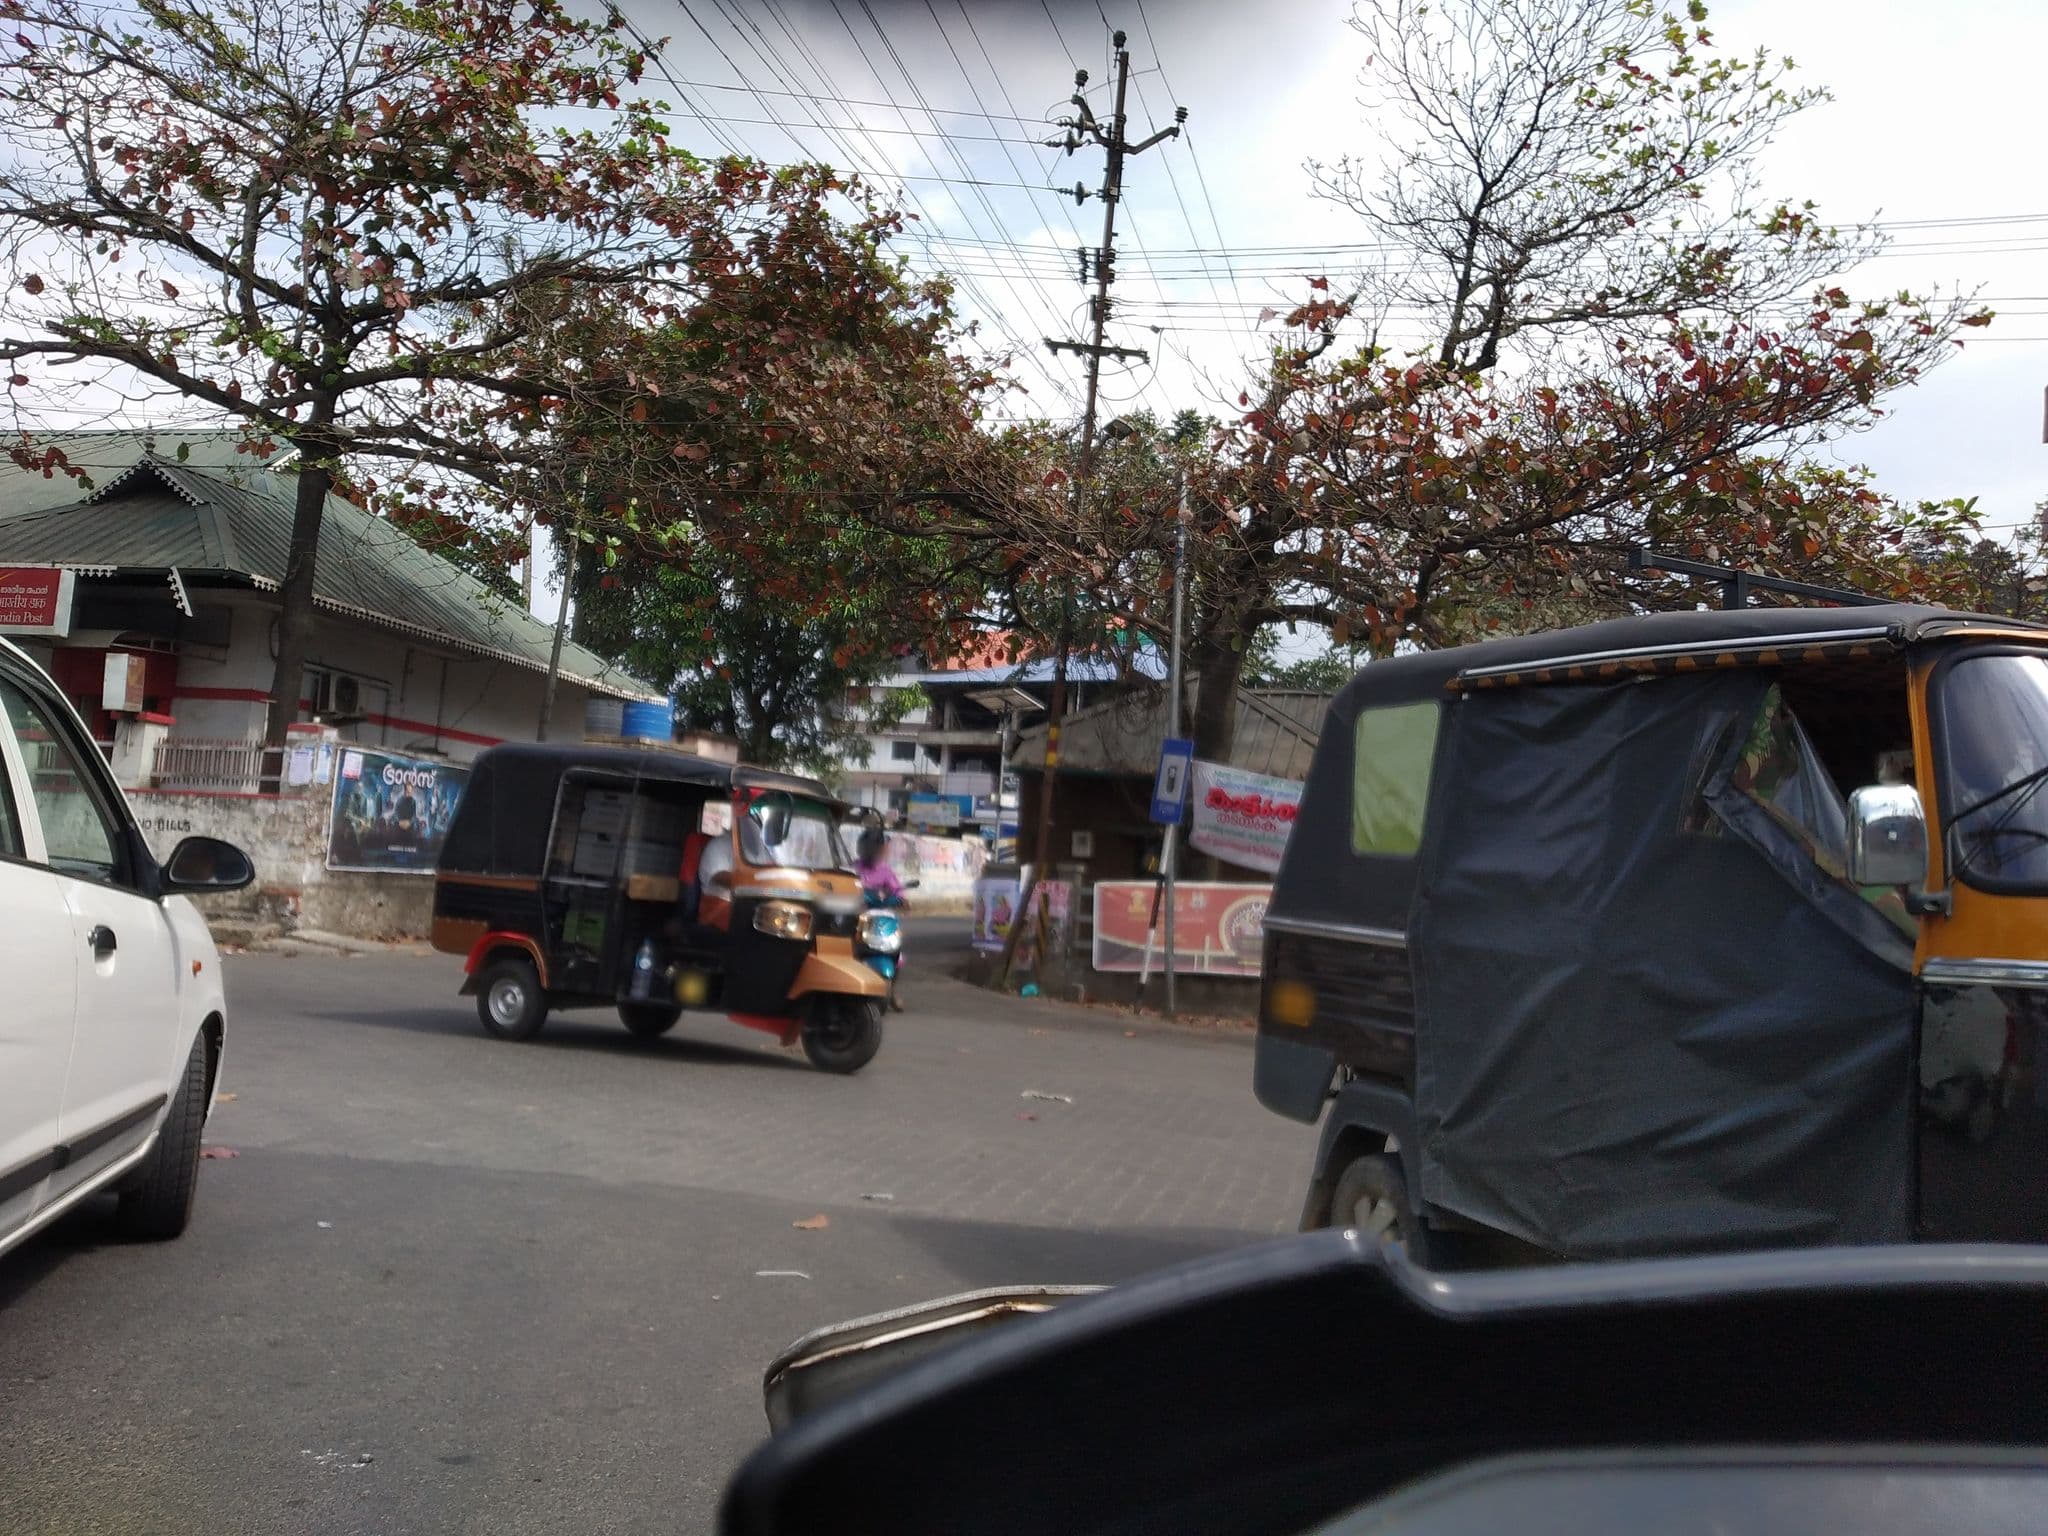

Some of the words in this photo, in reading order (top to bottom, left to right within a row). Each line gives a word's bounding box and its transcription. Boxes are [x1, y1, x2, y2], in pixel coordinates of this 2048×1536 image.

[28, 597, 46, 609] डाक
[0, 612, 21, 623] ndia
[23, 611, 43, 623] Post
